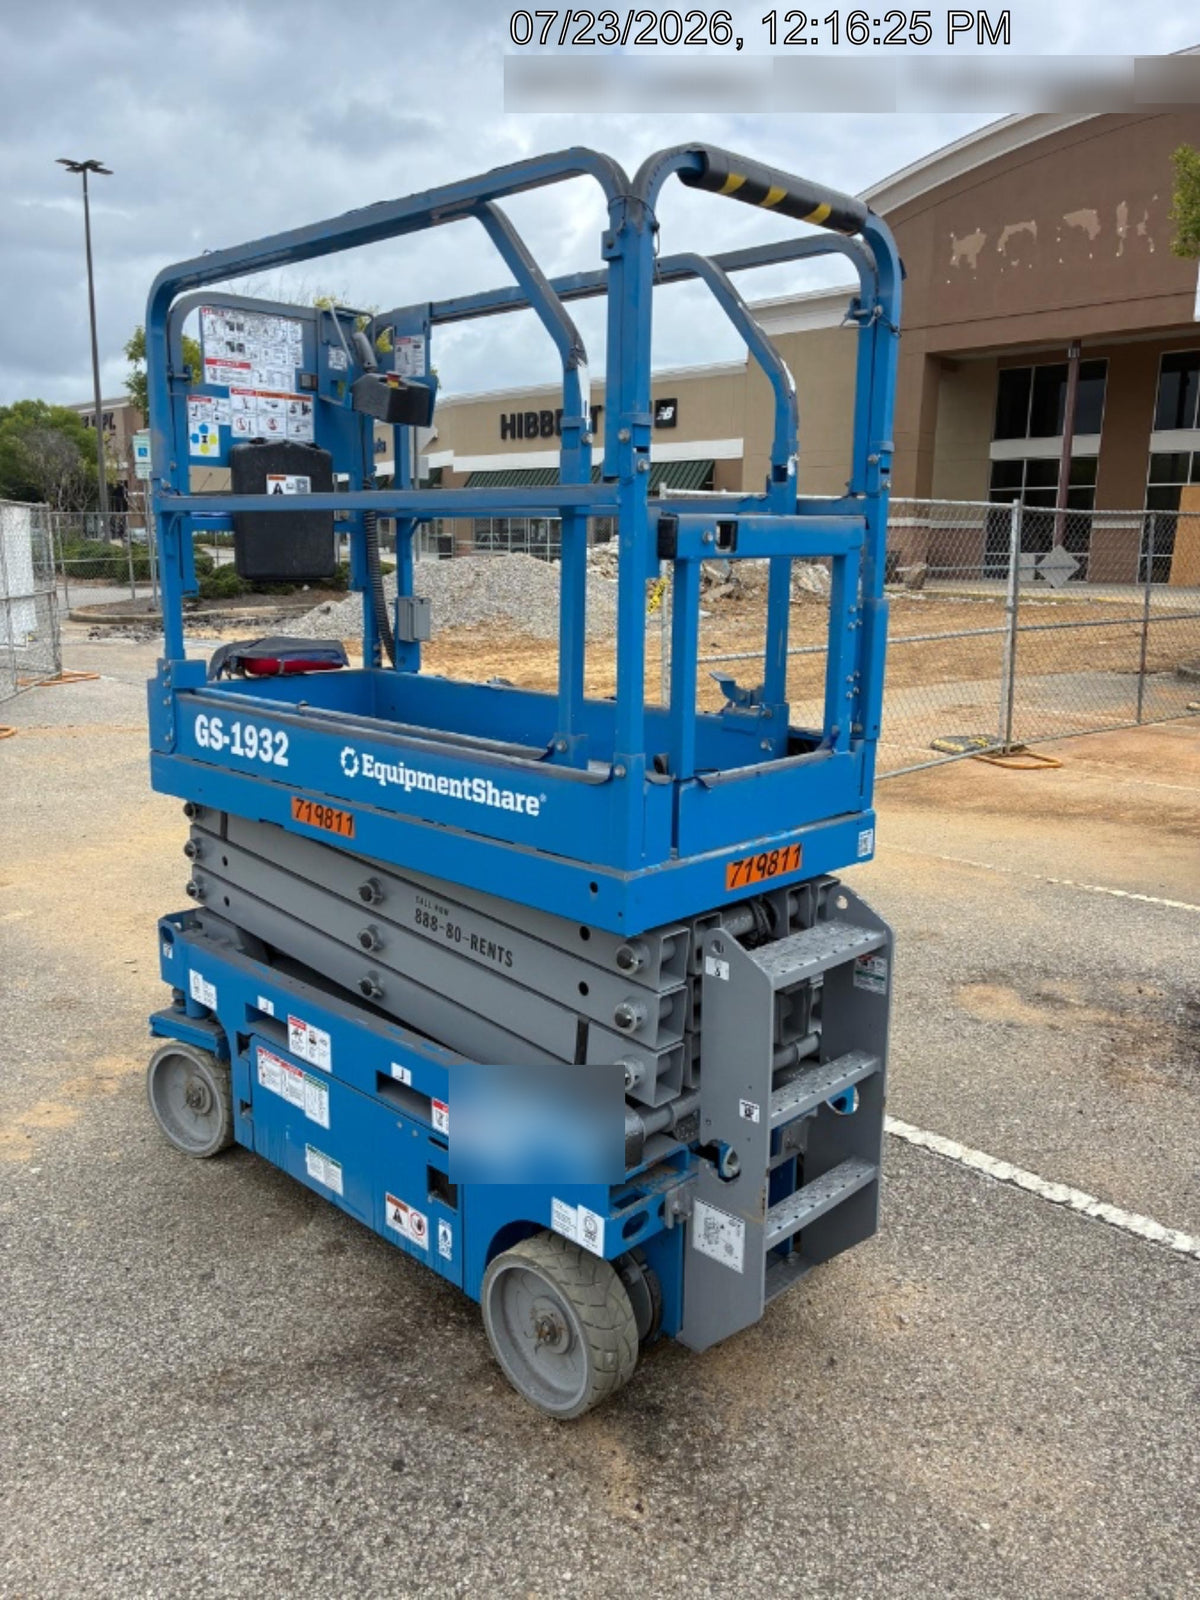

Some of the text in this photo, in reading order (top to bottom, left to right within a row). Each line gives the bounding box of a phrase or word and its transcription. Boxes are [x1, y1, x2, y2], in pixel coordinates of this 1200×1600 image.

[194, 713, 290, 767] GS-1932
[294, 799, 354, 836] 719811
[729, 843, 802, 888] 719811
[415, 907, 514, 968] 888-80-RENTS
